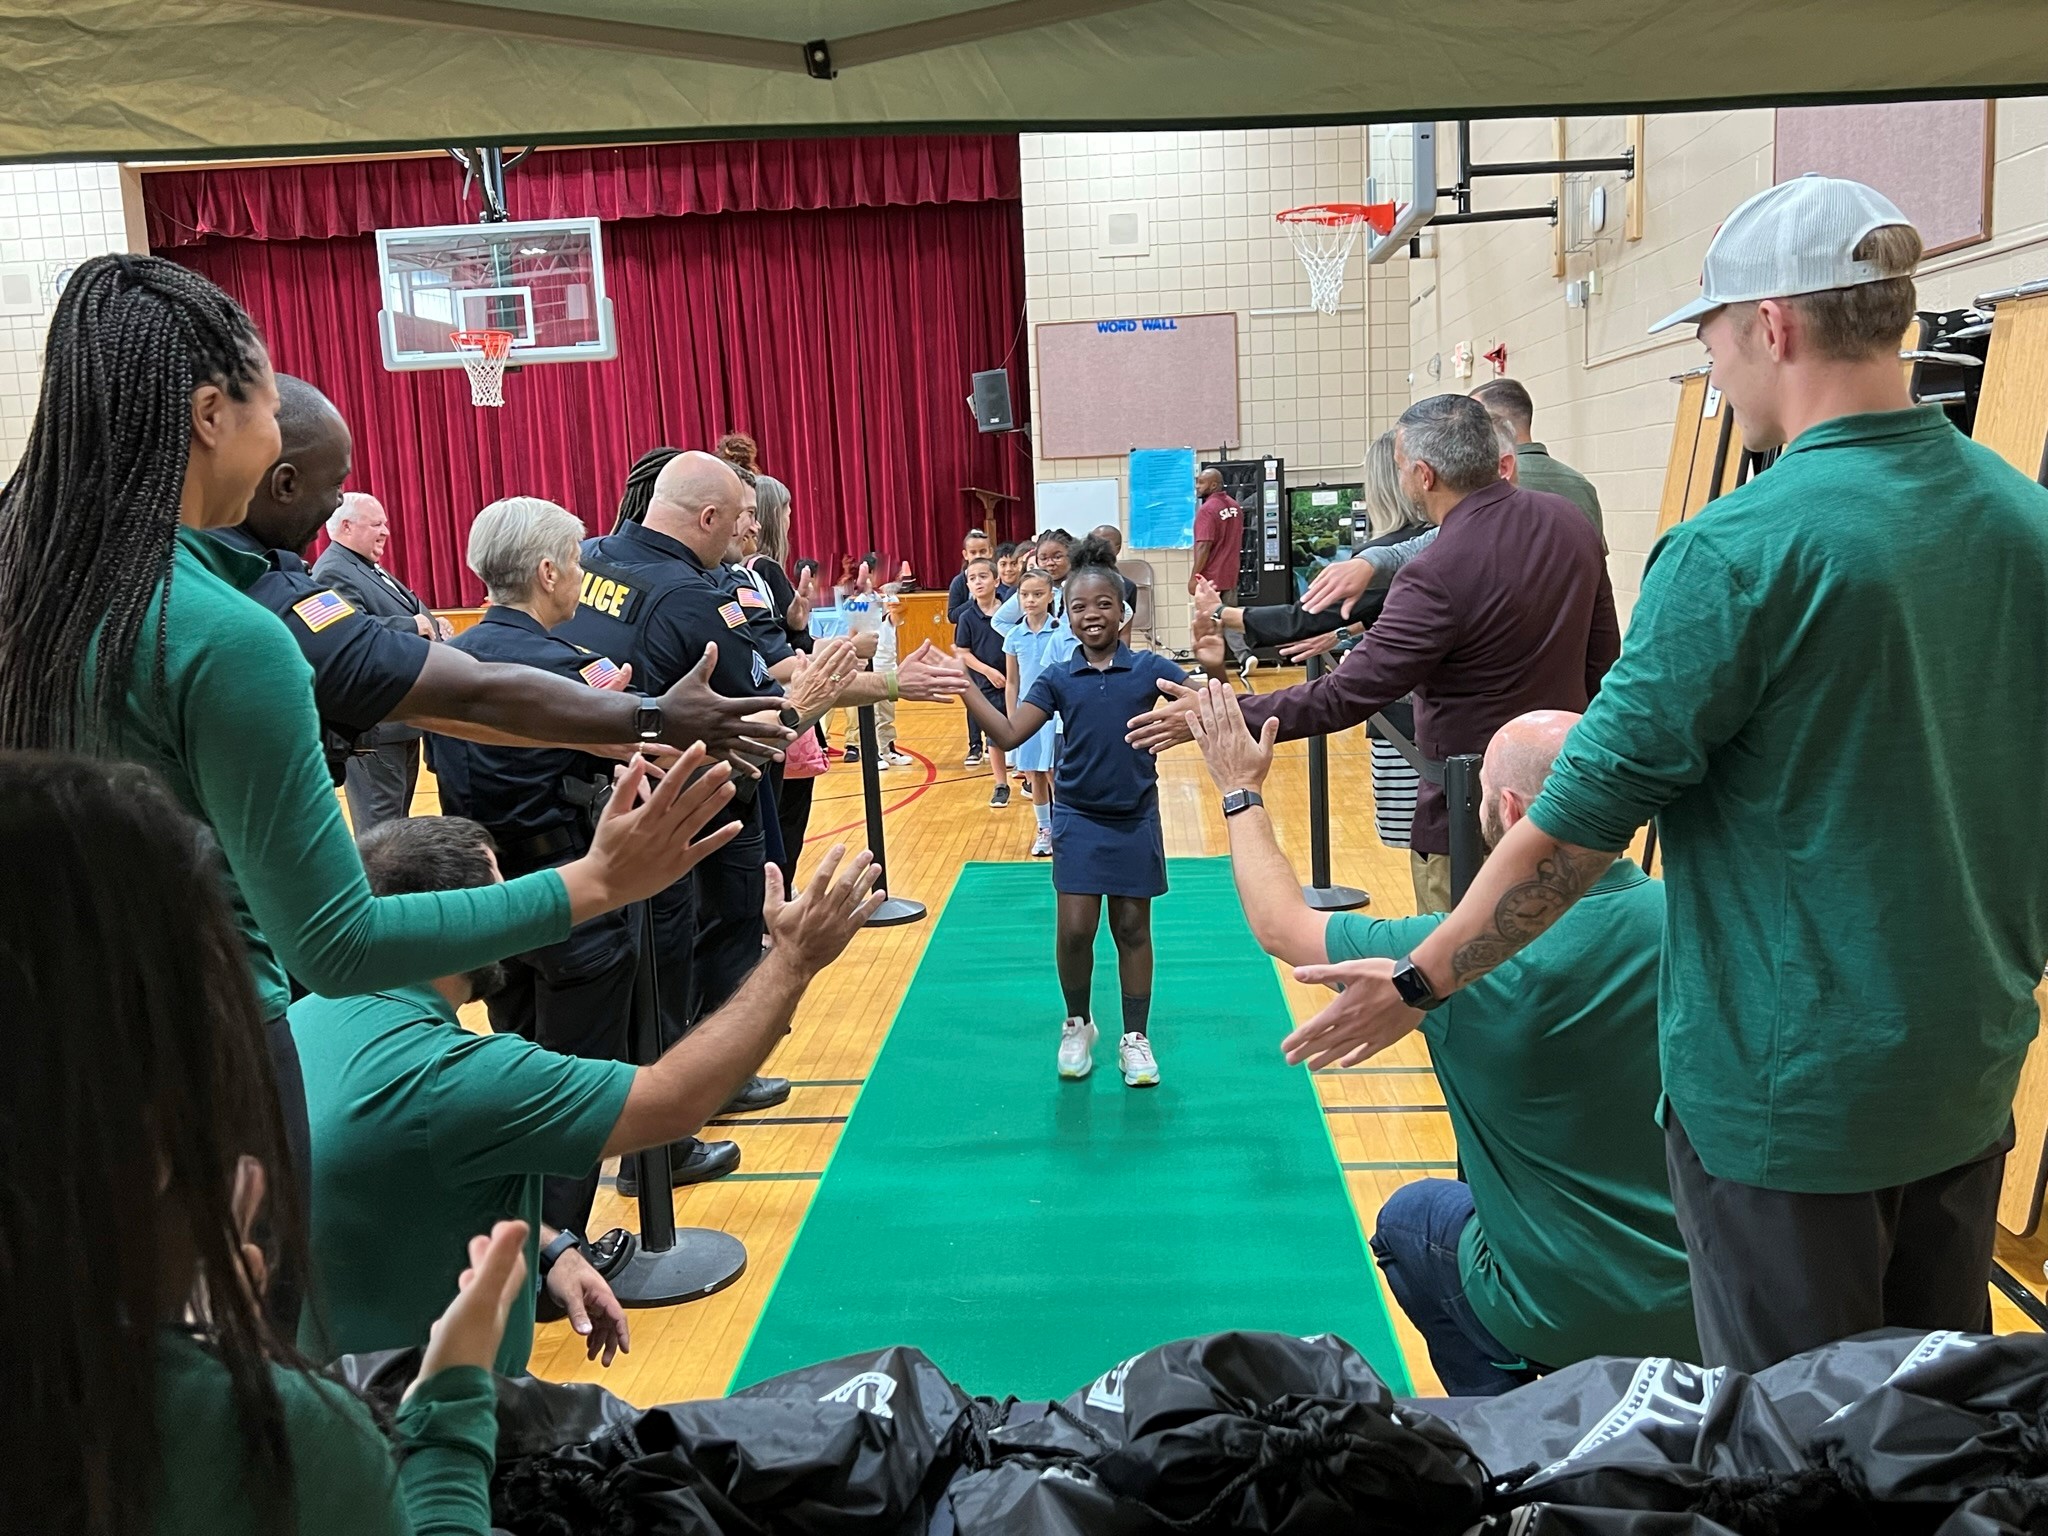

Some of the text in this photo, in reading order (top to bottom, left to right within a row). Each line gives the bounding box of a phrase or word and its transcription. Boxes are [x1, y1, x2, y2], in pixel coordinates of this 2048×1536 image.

[1097, 318, 1177, 333] WORD WALL
[579, 572, 630, 617] LICE
